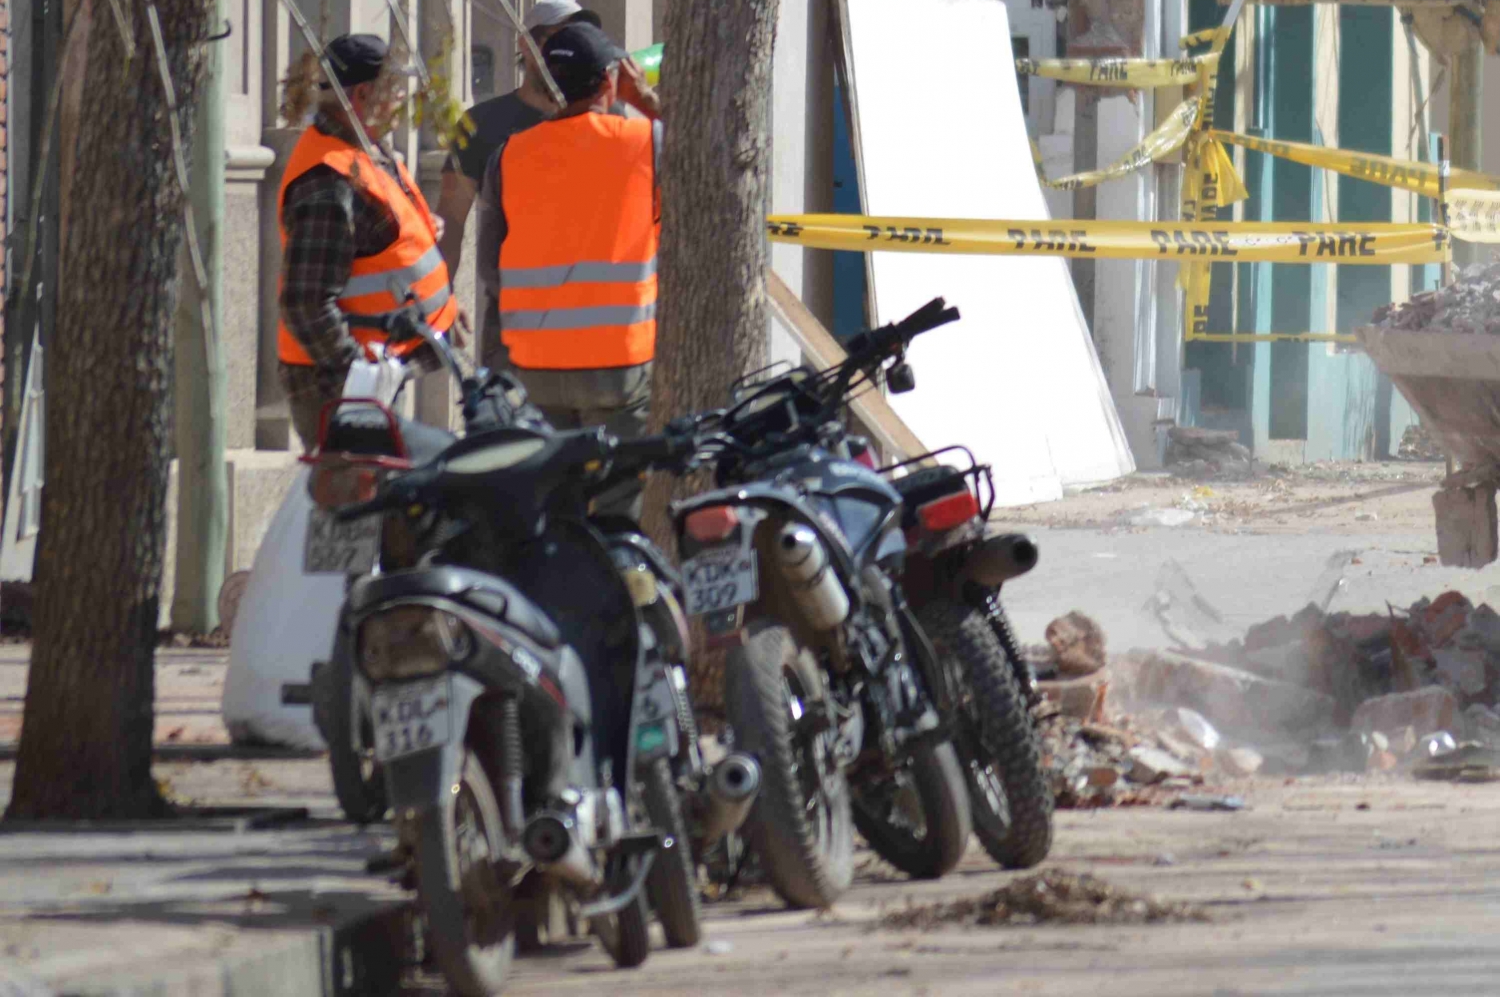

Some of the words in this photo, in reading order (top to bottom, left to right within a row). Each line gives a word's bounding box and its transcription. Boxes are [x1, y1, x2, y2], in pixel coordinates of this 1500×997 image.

[1007, 229, 1096, 252] PARE
[1150, 230, 1238, 256] PARE
[1293, 231, 1376, 257] PARE
[693, 583, 737, 612] 309
